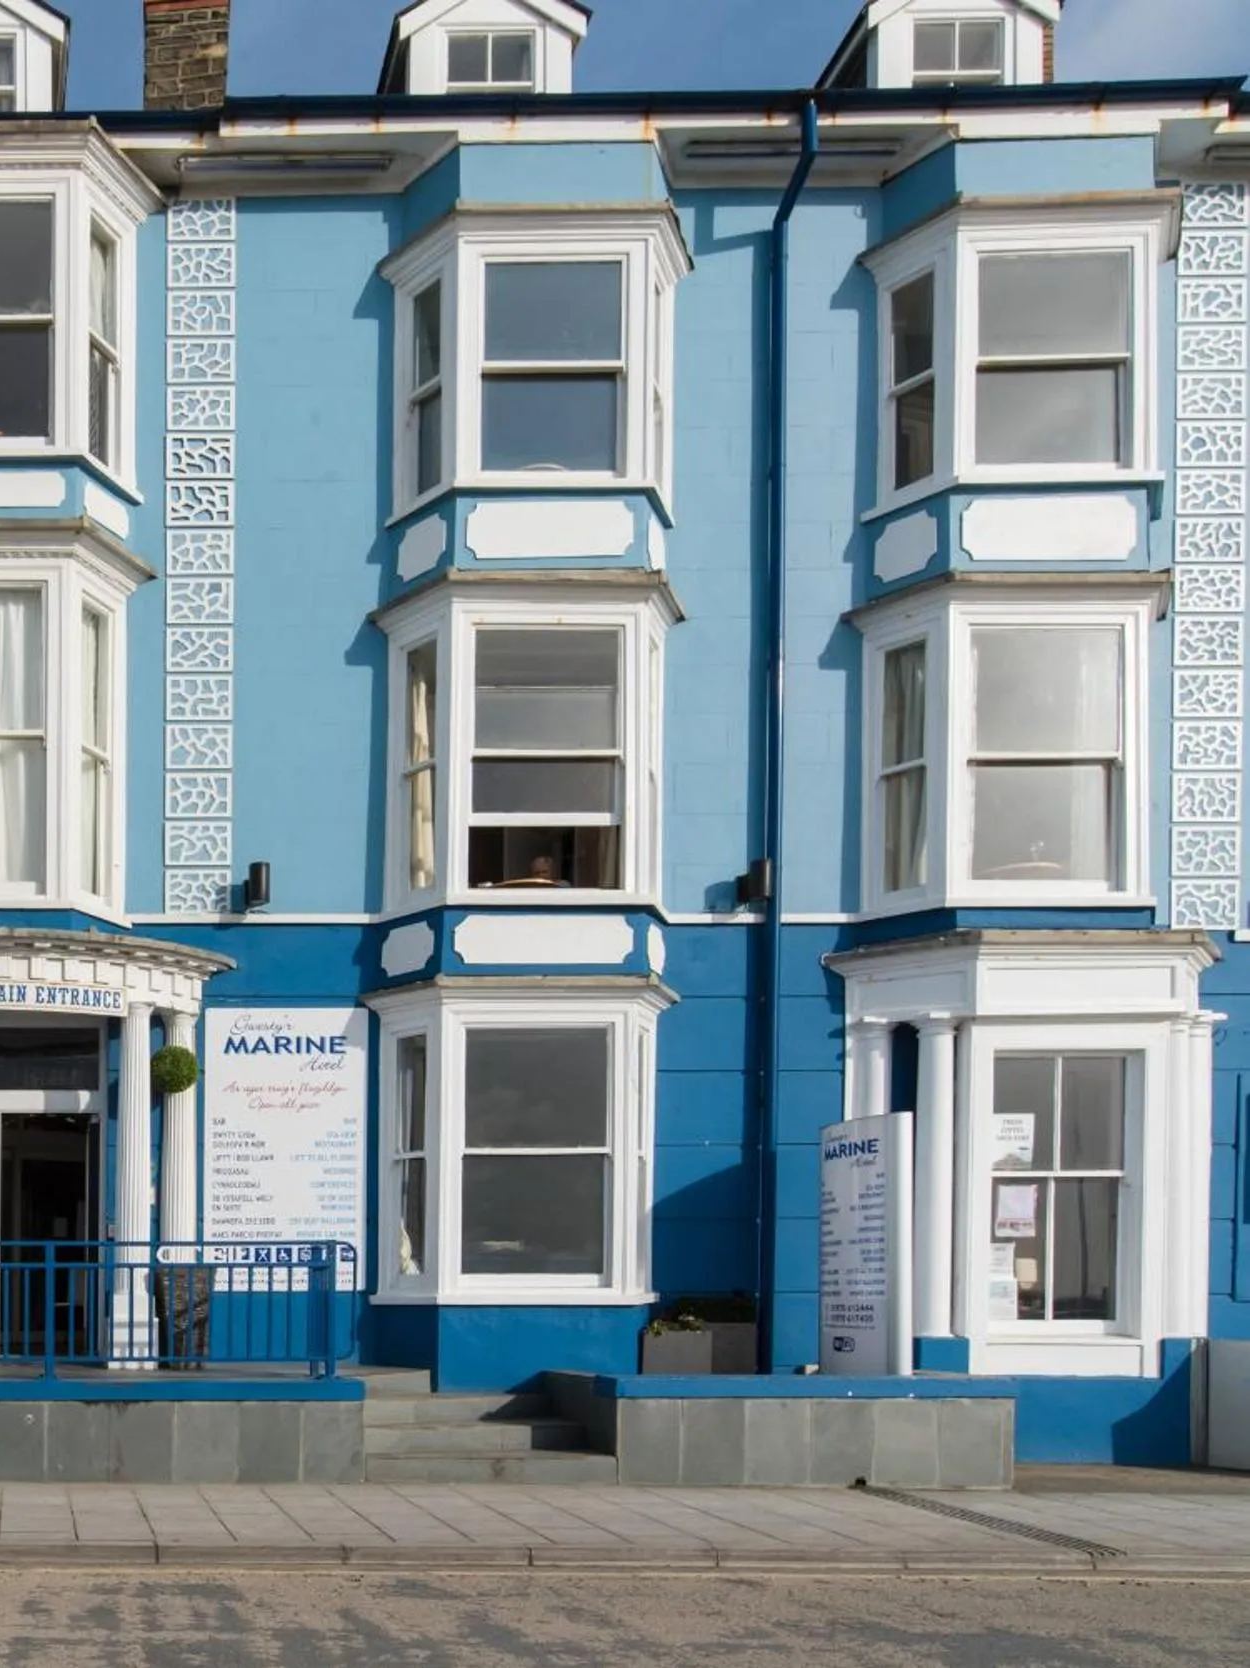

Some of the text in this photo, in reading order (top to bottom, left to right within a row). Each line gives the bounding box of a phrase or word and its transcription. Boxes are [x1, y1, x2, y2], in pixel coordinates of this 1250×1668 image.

[36, 986, 121, 1008] ENTRANCE
[224, 1036, 348, 1054] MARINE
[300, 1055, 345, 1072] Hotel
[824, 1138, 879, 1161] MARINE
